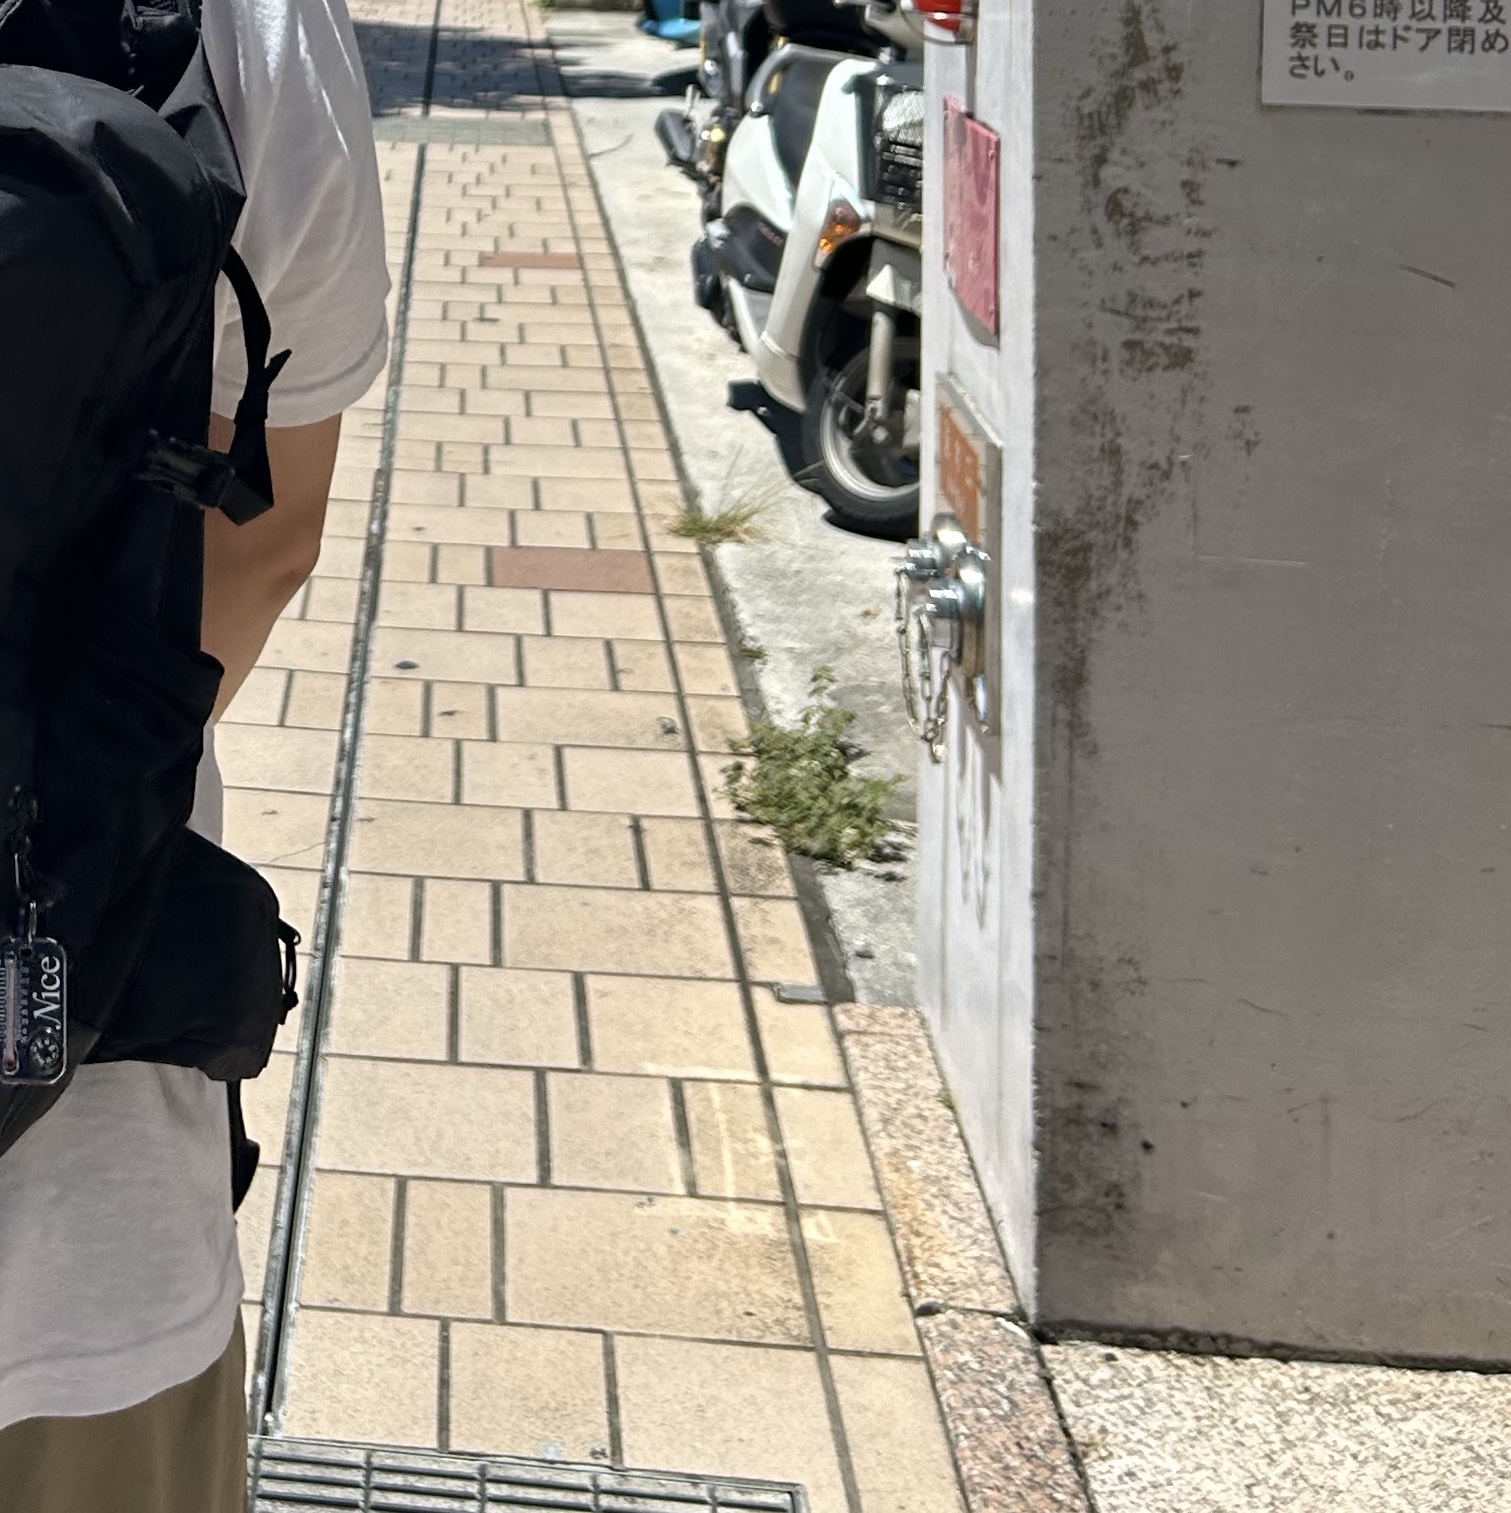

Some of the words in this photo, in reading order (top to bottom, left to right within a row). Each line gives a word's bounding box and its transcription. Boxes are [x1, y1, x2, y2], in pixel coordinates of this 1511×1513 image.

[1289, 21, 1510, 55] 祭日はドア閉め
[1289, 52, 1355, 82] さい。
[32, 955, 62, 1031] Nice
